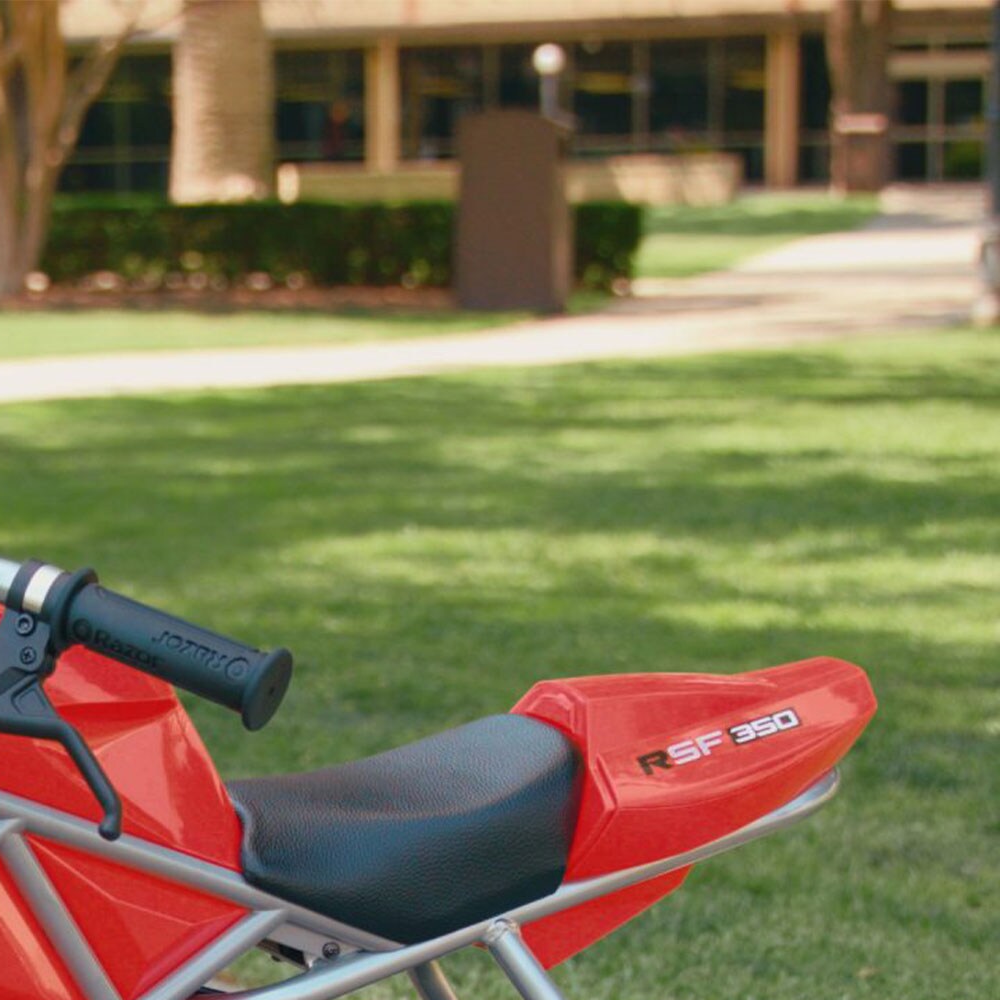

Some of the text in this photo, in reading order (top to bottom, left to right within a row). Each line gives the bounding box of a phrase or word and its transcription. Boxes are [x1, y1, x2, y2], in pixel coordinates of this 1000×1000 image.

[95, 629, 167, 669] Razor
[637, 707, 802, 775] RSF 350
